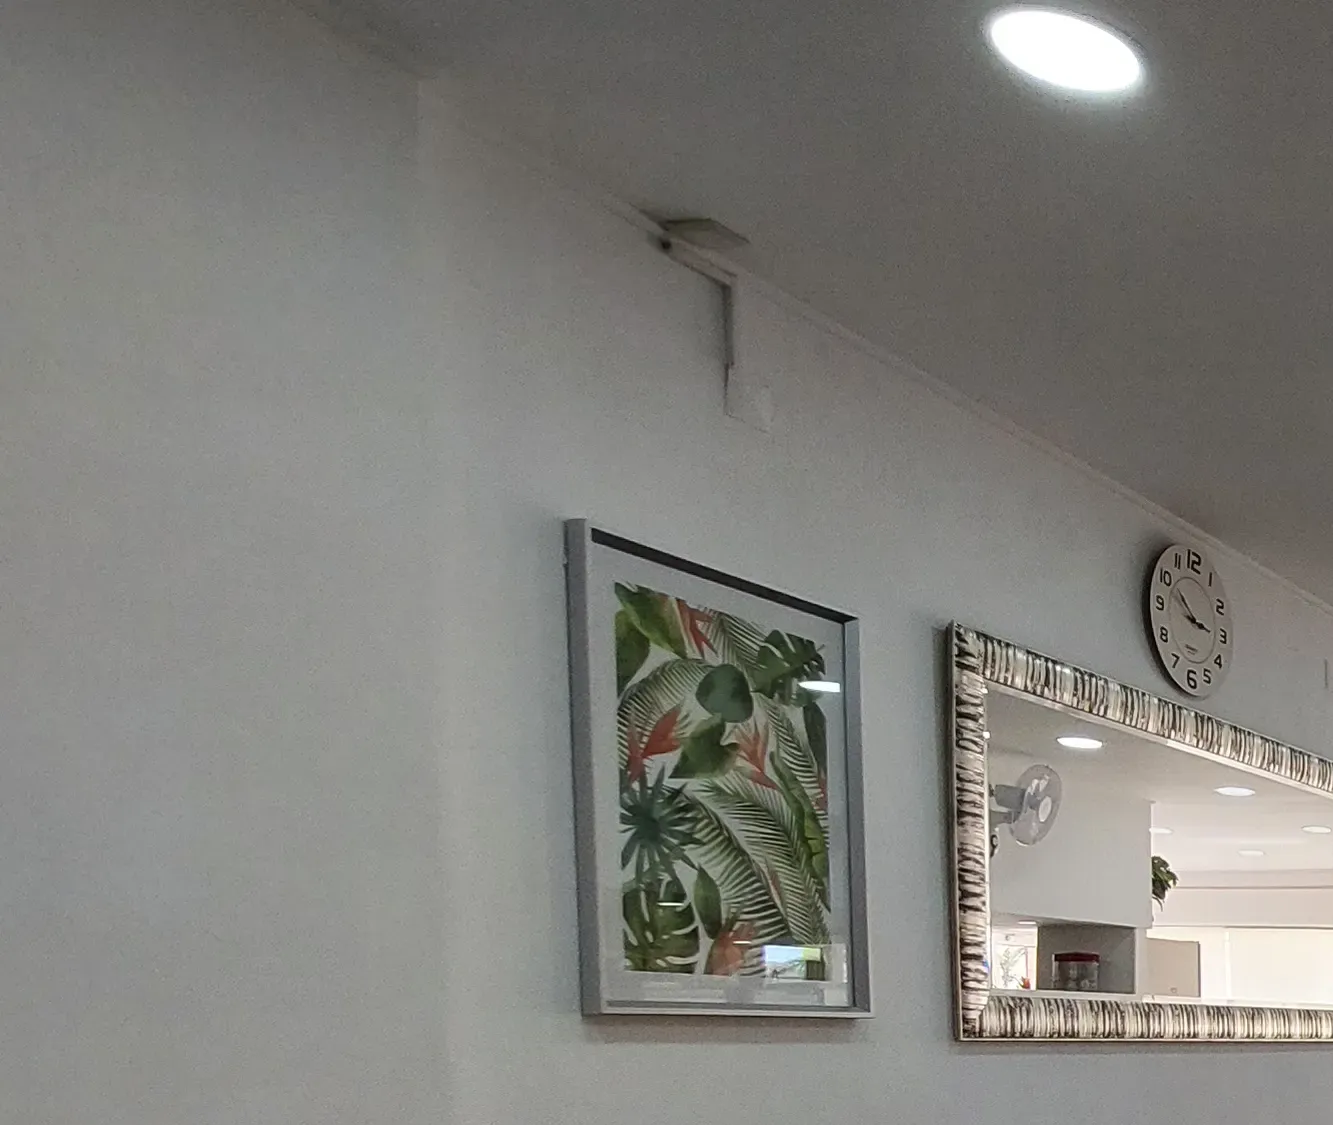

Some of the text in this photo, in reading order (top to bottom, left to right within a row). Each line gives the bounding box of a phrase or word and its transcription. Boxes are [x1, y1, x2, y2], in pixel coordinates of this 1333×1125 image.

[1174, 553, 1181, 569] 11
[1187, 549, 1201, 575] 12
[1160, 568, 1171, 586] 10
[1208, 572, 1212, 586] 1
[1156, 595, 1164, 611] 9
[1216, 598, 1224, 615] 2
[1160, 627, 1168, 643] 8
[1220, 628, 1227, 644] 3
[1171, 653, 1180, 668] 7
[1214, 654, 1222, 668] 4
[1186, 669, 1197, 689] 6
[1203, 668, 1212, 684] 5
